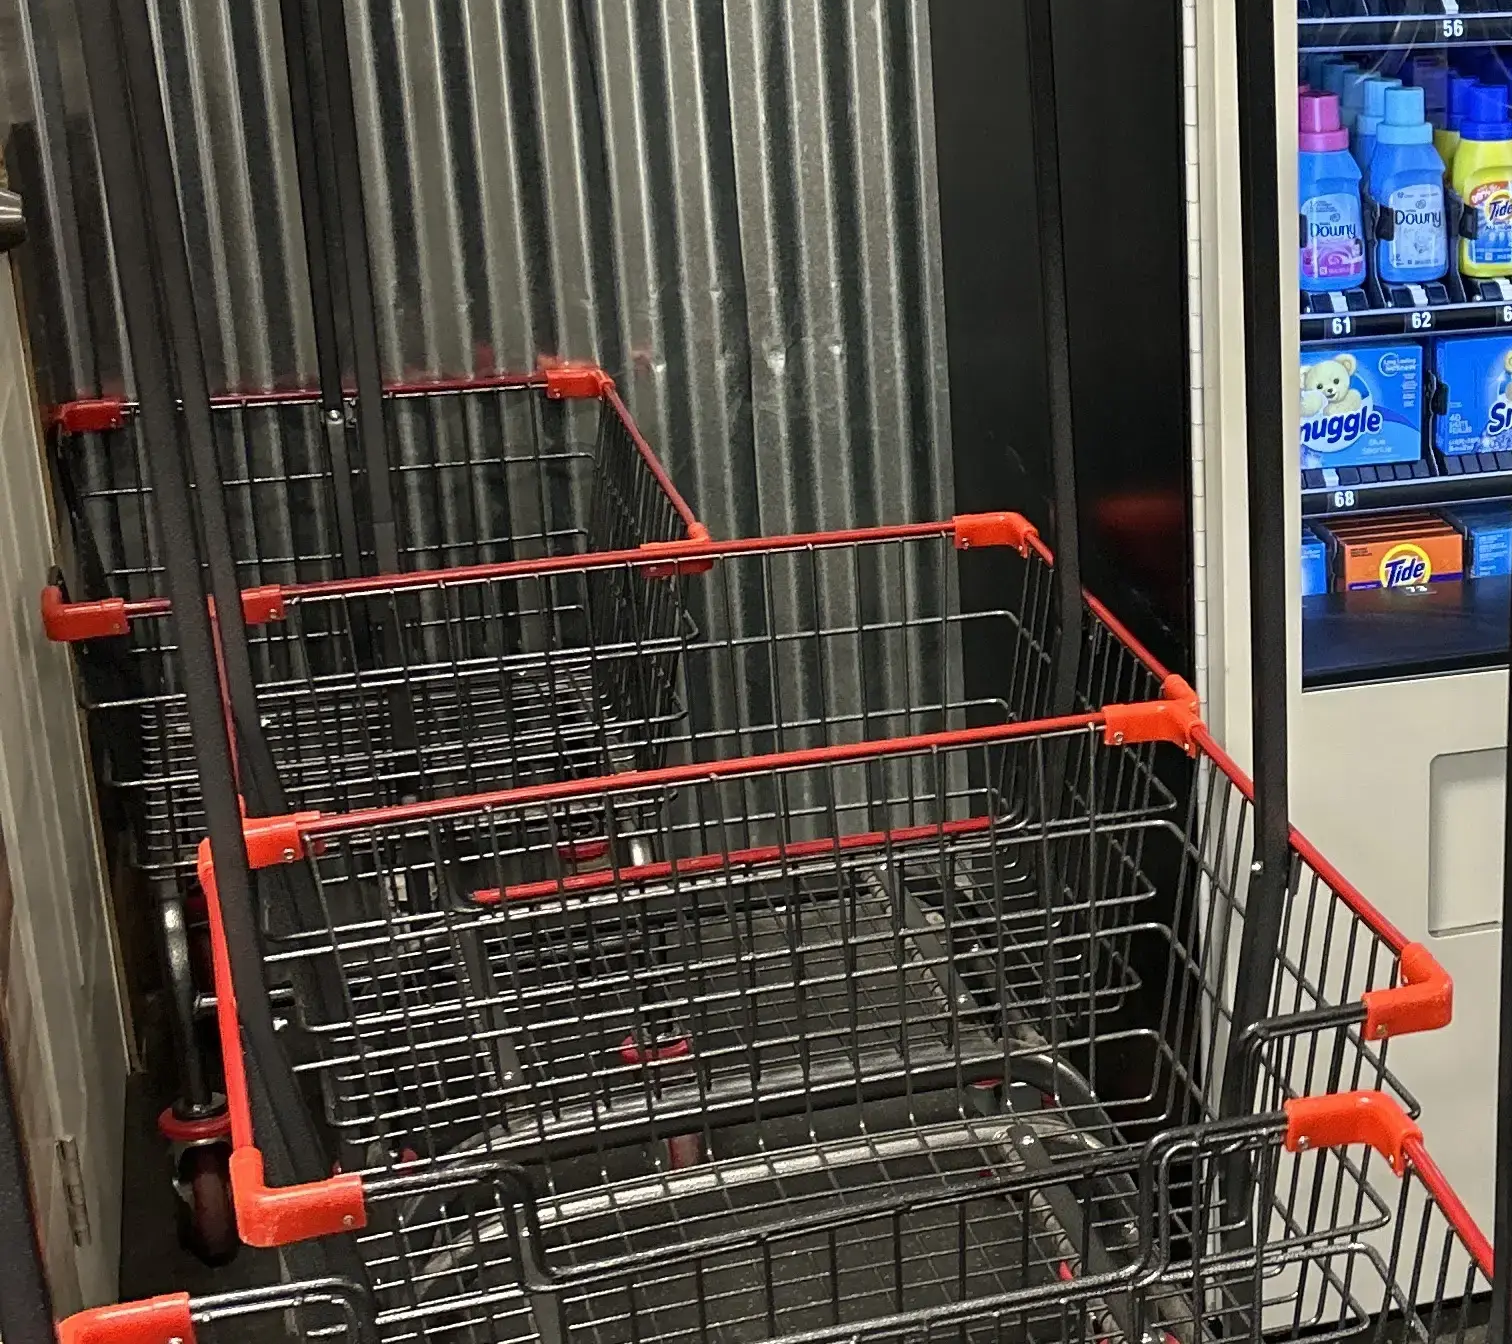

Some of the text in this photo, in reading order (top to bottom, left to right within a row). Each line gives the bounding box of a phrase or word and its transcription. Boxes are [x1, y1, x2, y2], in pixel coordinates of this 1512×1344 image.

[1443, 19, 1464, 38] 56
[1395, 210, 1442, 228] Downy
[1310, 222, 1356, 239] Downy
[1332, 318, 1351, 334] 61
[1412, 312, 1431, 328] 62
[1300, 406, 1382, 443] nuggle
[1335, 491, 1354, 507] 68
[1384, 558, 1426, 587] Tide
